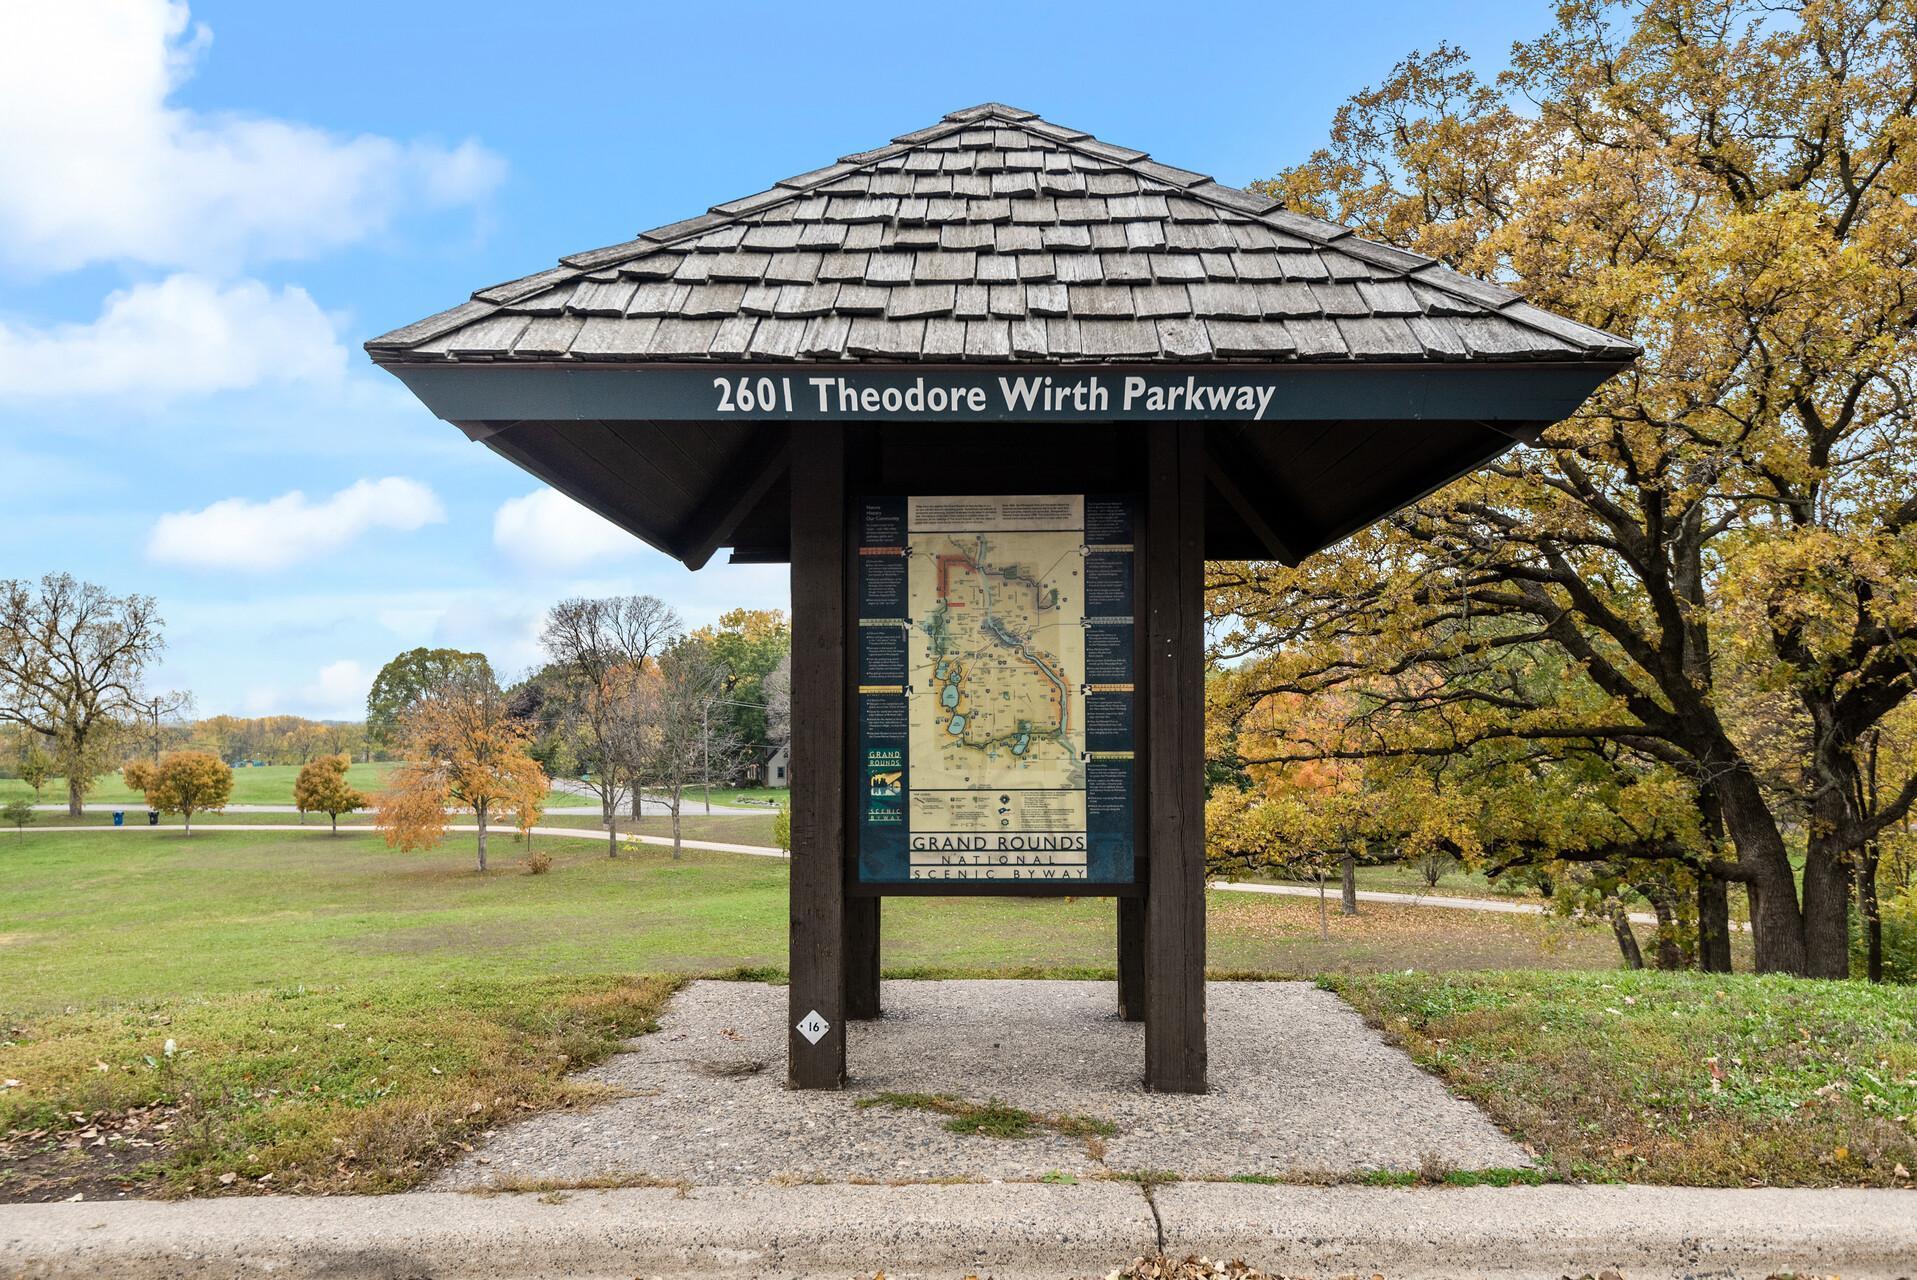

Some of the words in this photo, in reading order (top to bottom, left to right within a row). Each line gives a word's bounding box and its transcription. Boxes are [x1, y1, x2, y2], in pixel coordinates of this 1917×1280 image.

[713, 377, 792, 412] 2601
[809, 376, 986, 412] Theodore
[999, 375, 1109, 411] Wirth
[1123, 375, 1276, 420] Parkway
[912, 836, 987, 850] GRAND
[998, 836, 1085, 850] ROUNDS
[941, 855, 1055, 865] NATIONAL
[914, 869, 994, 879] SCENIC
[1013, 869, 1085, 879] BYWAY
[809, 1022, 820, 1032] 16
